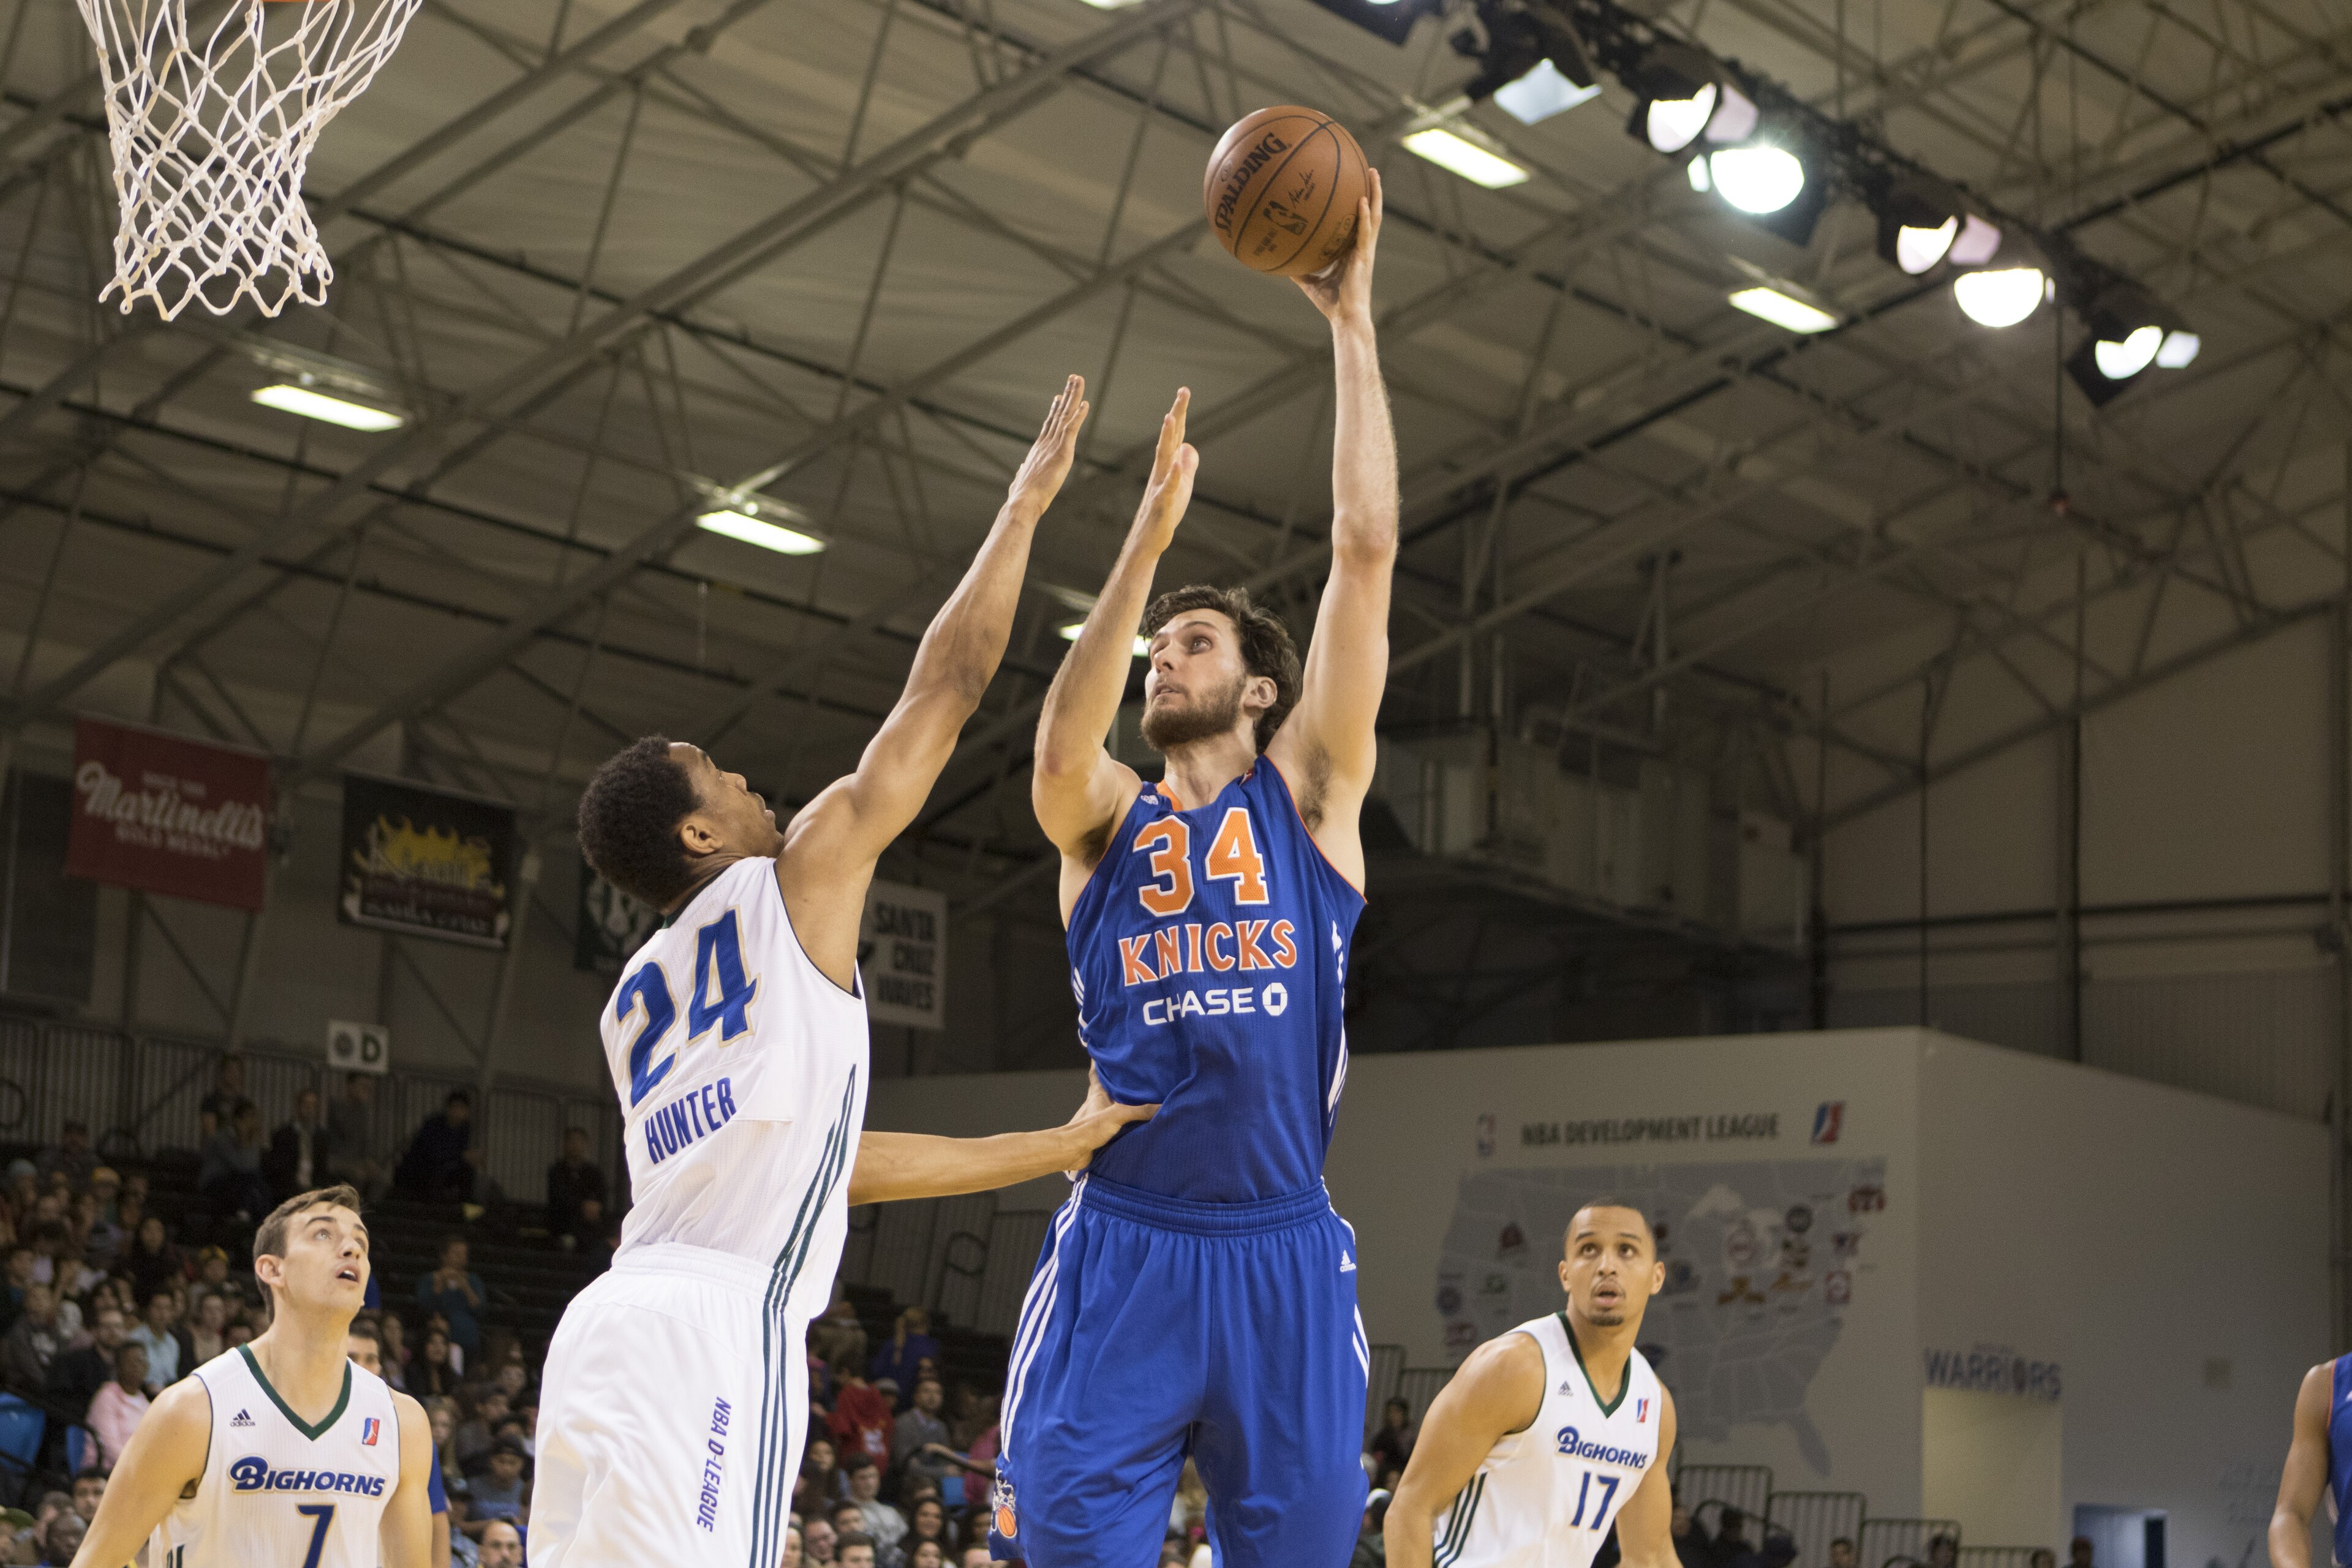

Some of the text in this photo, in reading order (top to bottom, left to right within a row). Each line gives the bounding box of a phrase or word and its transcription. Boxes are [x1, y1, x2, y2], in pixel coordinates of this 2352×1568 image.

[1215, 132, 1287, 238] SPALDING
[1133, 807, 1270, 917] 34
[875, 900, 935, 941] SANTA
[892, 940, 934, 976] CRUZ
[1118, 919, 1297, 987] KNICKS
[616, 905, 761, 1109] 24
[1143, 987, 1256, 1025] CHASE
[361, 1031, 381, 1062] D
[644, 1077, 737, 1165] HUNTER
[1521, 1111, 1778, 1145] NBA DEVELOPMENT LEAGUE
[1924, 1349, 2062, 1401] WARRIORS
[696, 1396, 732, 1532] NBA D-LEAGUE
[1569, 1471, 1621, 1532] 17
[296, 1504, 335, 1568] 7
